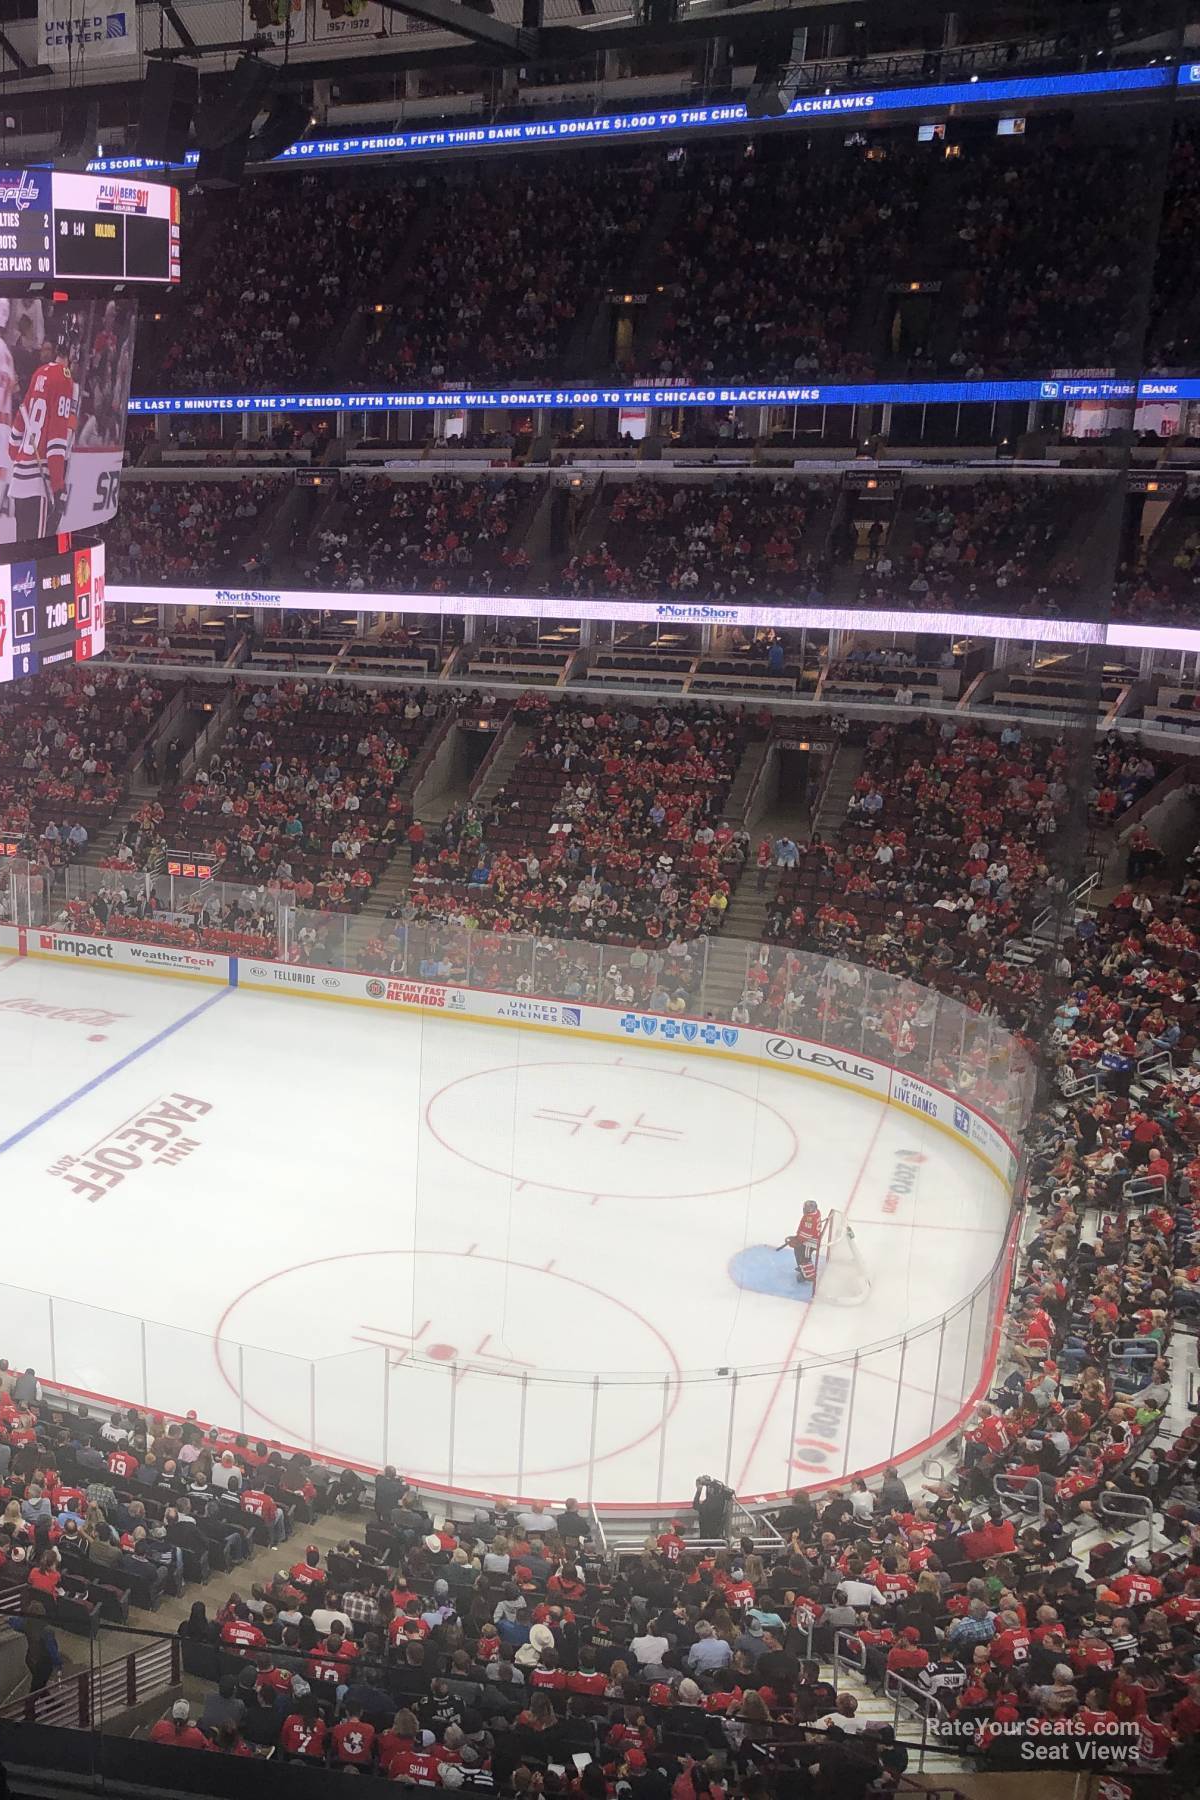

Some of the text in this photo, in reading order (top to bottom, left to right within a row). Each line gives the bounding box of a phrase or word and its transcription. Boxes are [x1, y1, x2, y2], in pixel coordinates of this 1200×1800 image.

[45, 16, 103, 32] UNITED
[46, 32, 103, 46] CENTER
[301, 145, 314, 153] OF
[318, 143, 339, 152] THE
[362, 137, 407, 149] PERIOD,
[411, 134, 444, 145] FIFTH
[448, 131, 484, 142] THIRD
[488, 128, 522, 140] BANK
[525, 124, 556, 137] WILL
[560, 120, 611, 133] DONATE
[614, 116, 656, 130] $1,000
[660, 114, 677, 125] TO
[681, 112, 708, 123] THE
[110, 159, 142, 169] SCORE
[44, 214, 48, 228] 2
[44, 240, 49, 250] 0
[10, 257, 32, 271] PLAYS
[38, 256, 50, 271] 0/0
[144, 389, 820, 409] LAST 5 MINUTES OF THE 3RD PERIOD, FIFTH THIRD BANK WILL DONATE $1,000 TO THE CHICAGO BLACKHAWKS
[223, 591, 280, 602] NorthShore
[46, 602, 67, 629] 7:06
[665, 606, 738, 618] NorthShore
[22, 612, 28, 632] 1
[23, 657, 29, 673] 6
[52, 934, 113, 958] impact
[130, 948, 214, 967] WeatherTech
[273, 970, 316, 985] TELLURIDE
[388, 982, 448, 997] FREAKY FAST
[386, 991, 445, 1008] REWARDS
[509, 1000, 558, 1014] UNITED
[497, 1007, 558, 1023] AIRLINES
[796, 1047, 875, 1081] LEXUS
[894, 1086, 937, 1117] LIVE GAMES
[152, 1137, 202, 1166] NHL
[806, 1373, 850, 1439] BELFOR
[109, 1459, 127, 1475] 19
[409, 1763, 428, 1778] SHAW
